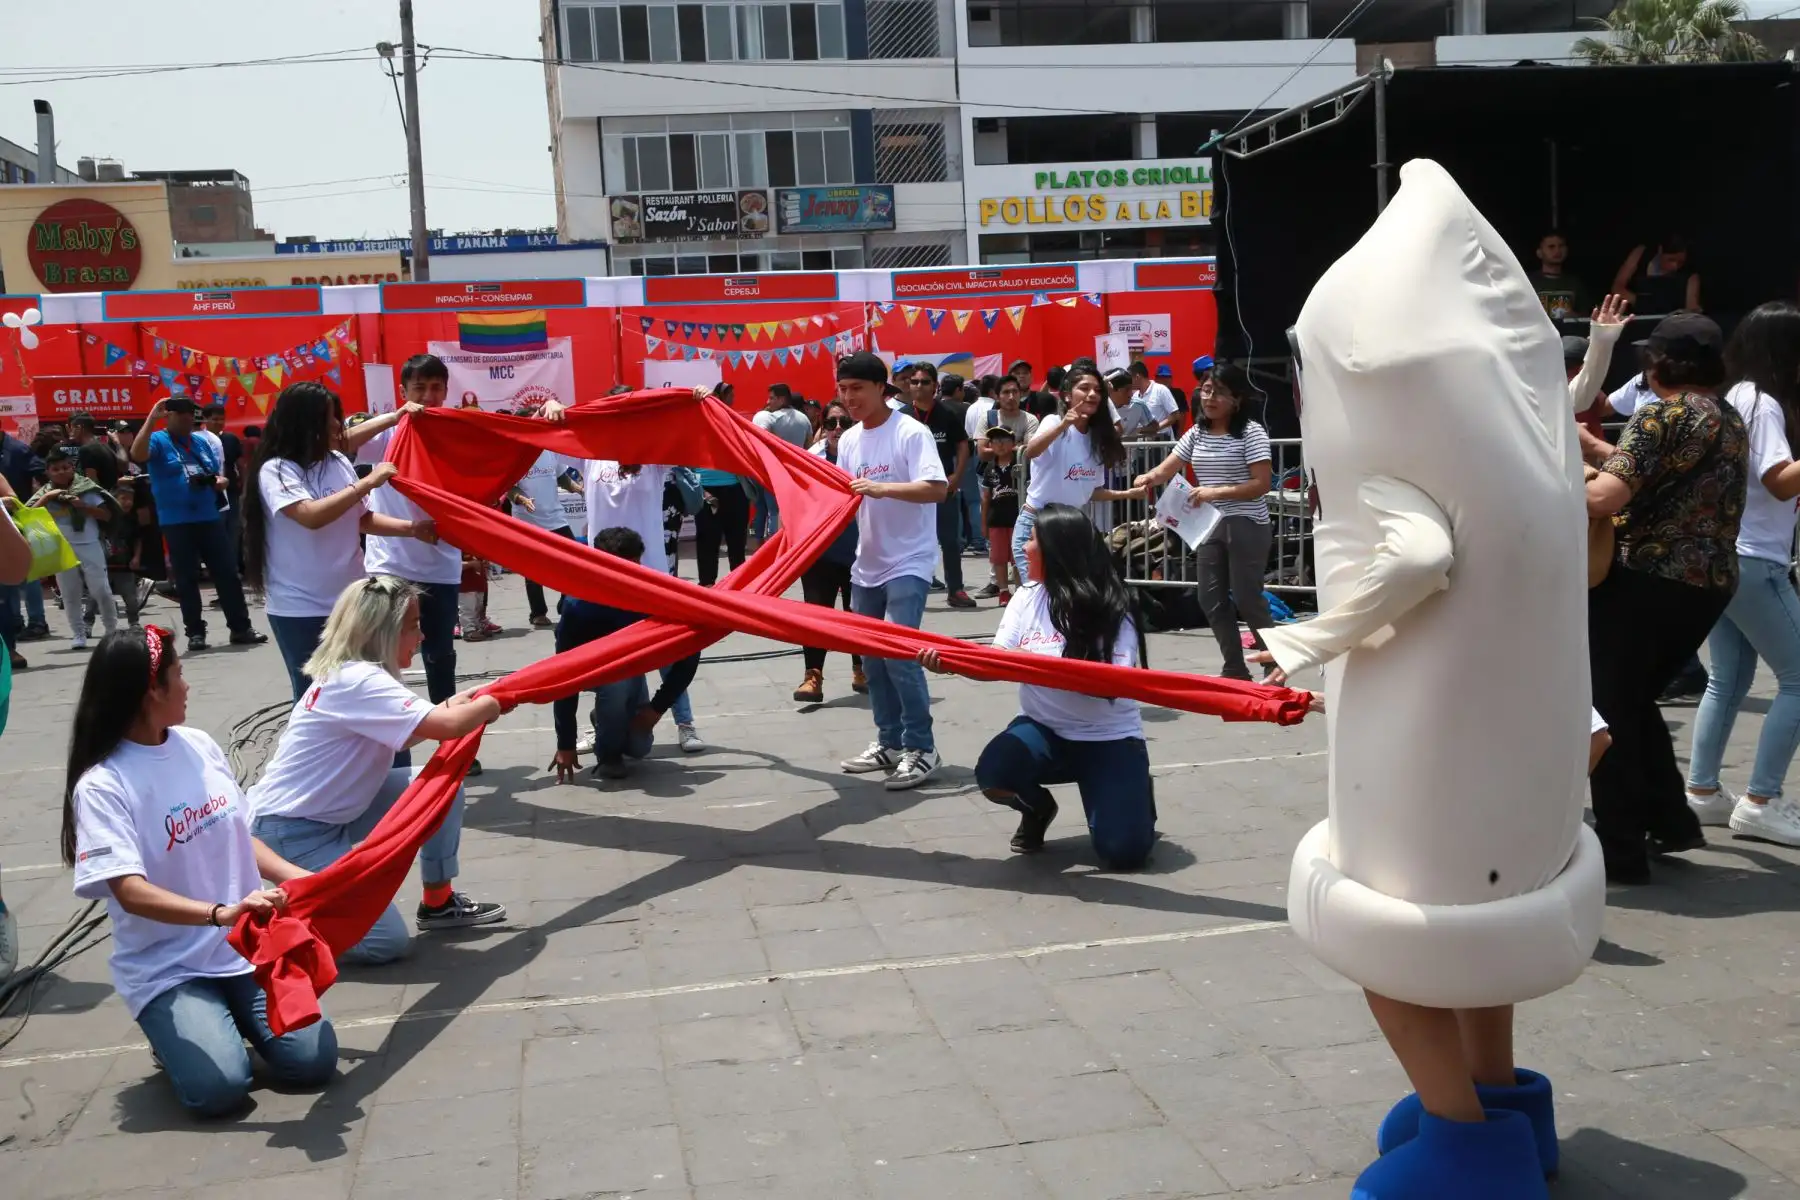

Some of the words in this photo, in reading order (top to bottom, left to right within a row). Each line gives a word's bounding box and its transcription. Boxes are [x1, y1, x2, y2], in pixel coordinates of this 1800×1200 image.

[1035, 169, 1129, 190] PLATOS
[646, 196, 694, 206] RESTAURANT
[697, 194, 734, 204] POLLERIA
[803, 193, 860, 220] Jenny
[979, 194, 1107, 227] POLLOS
[1116, 202, 1131, 221] A
[1179, 190, 1213, 218] BR
[645, 206, 687, 222] Sazón
[686, 216, 697, 231] y
[697, 218, 738, 232] Sabor
[35, 217, 137, 257] Maby's
[433, 238, 449, 250] DE
[45, 263, 130, 284] Brasa
[1198, 273, 1216, 281] ONG
[724, 287, 760, 296] CEPESJU
[896, 281, 944, 293] ASOCIACIÓN
[965, 280, 998, 289] IMPACTA
[998, 279, 1023, 288] SALUD
[1023, 278, 1029, 286] Y
[1030, 275, 1075, 286] EDUCACIÓN
[192, 303, 211, 311] AHF
[212, 300, 235, 310] PERÚ
[435, 295, 474, 304] INPACVIH
[480, 293, 533, 303] CONSEMPAR
[473, 355, 482, 364] DE
[489, 365, 515, 380] MCC
[53, 388, 131, 405] GRATIS
[563, 506, 587, 514] RATUITA
[183, 792, 228, 831] Prueba
